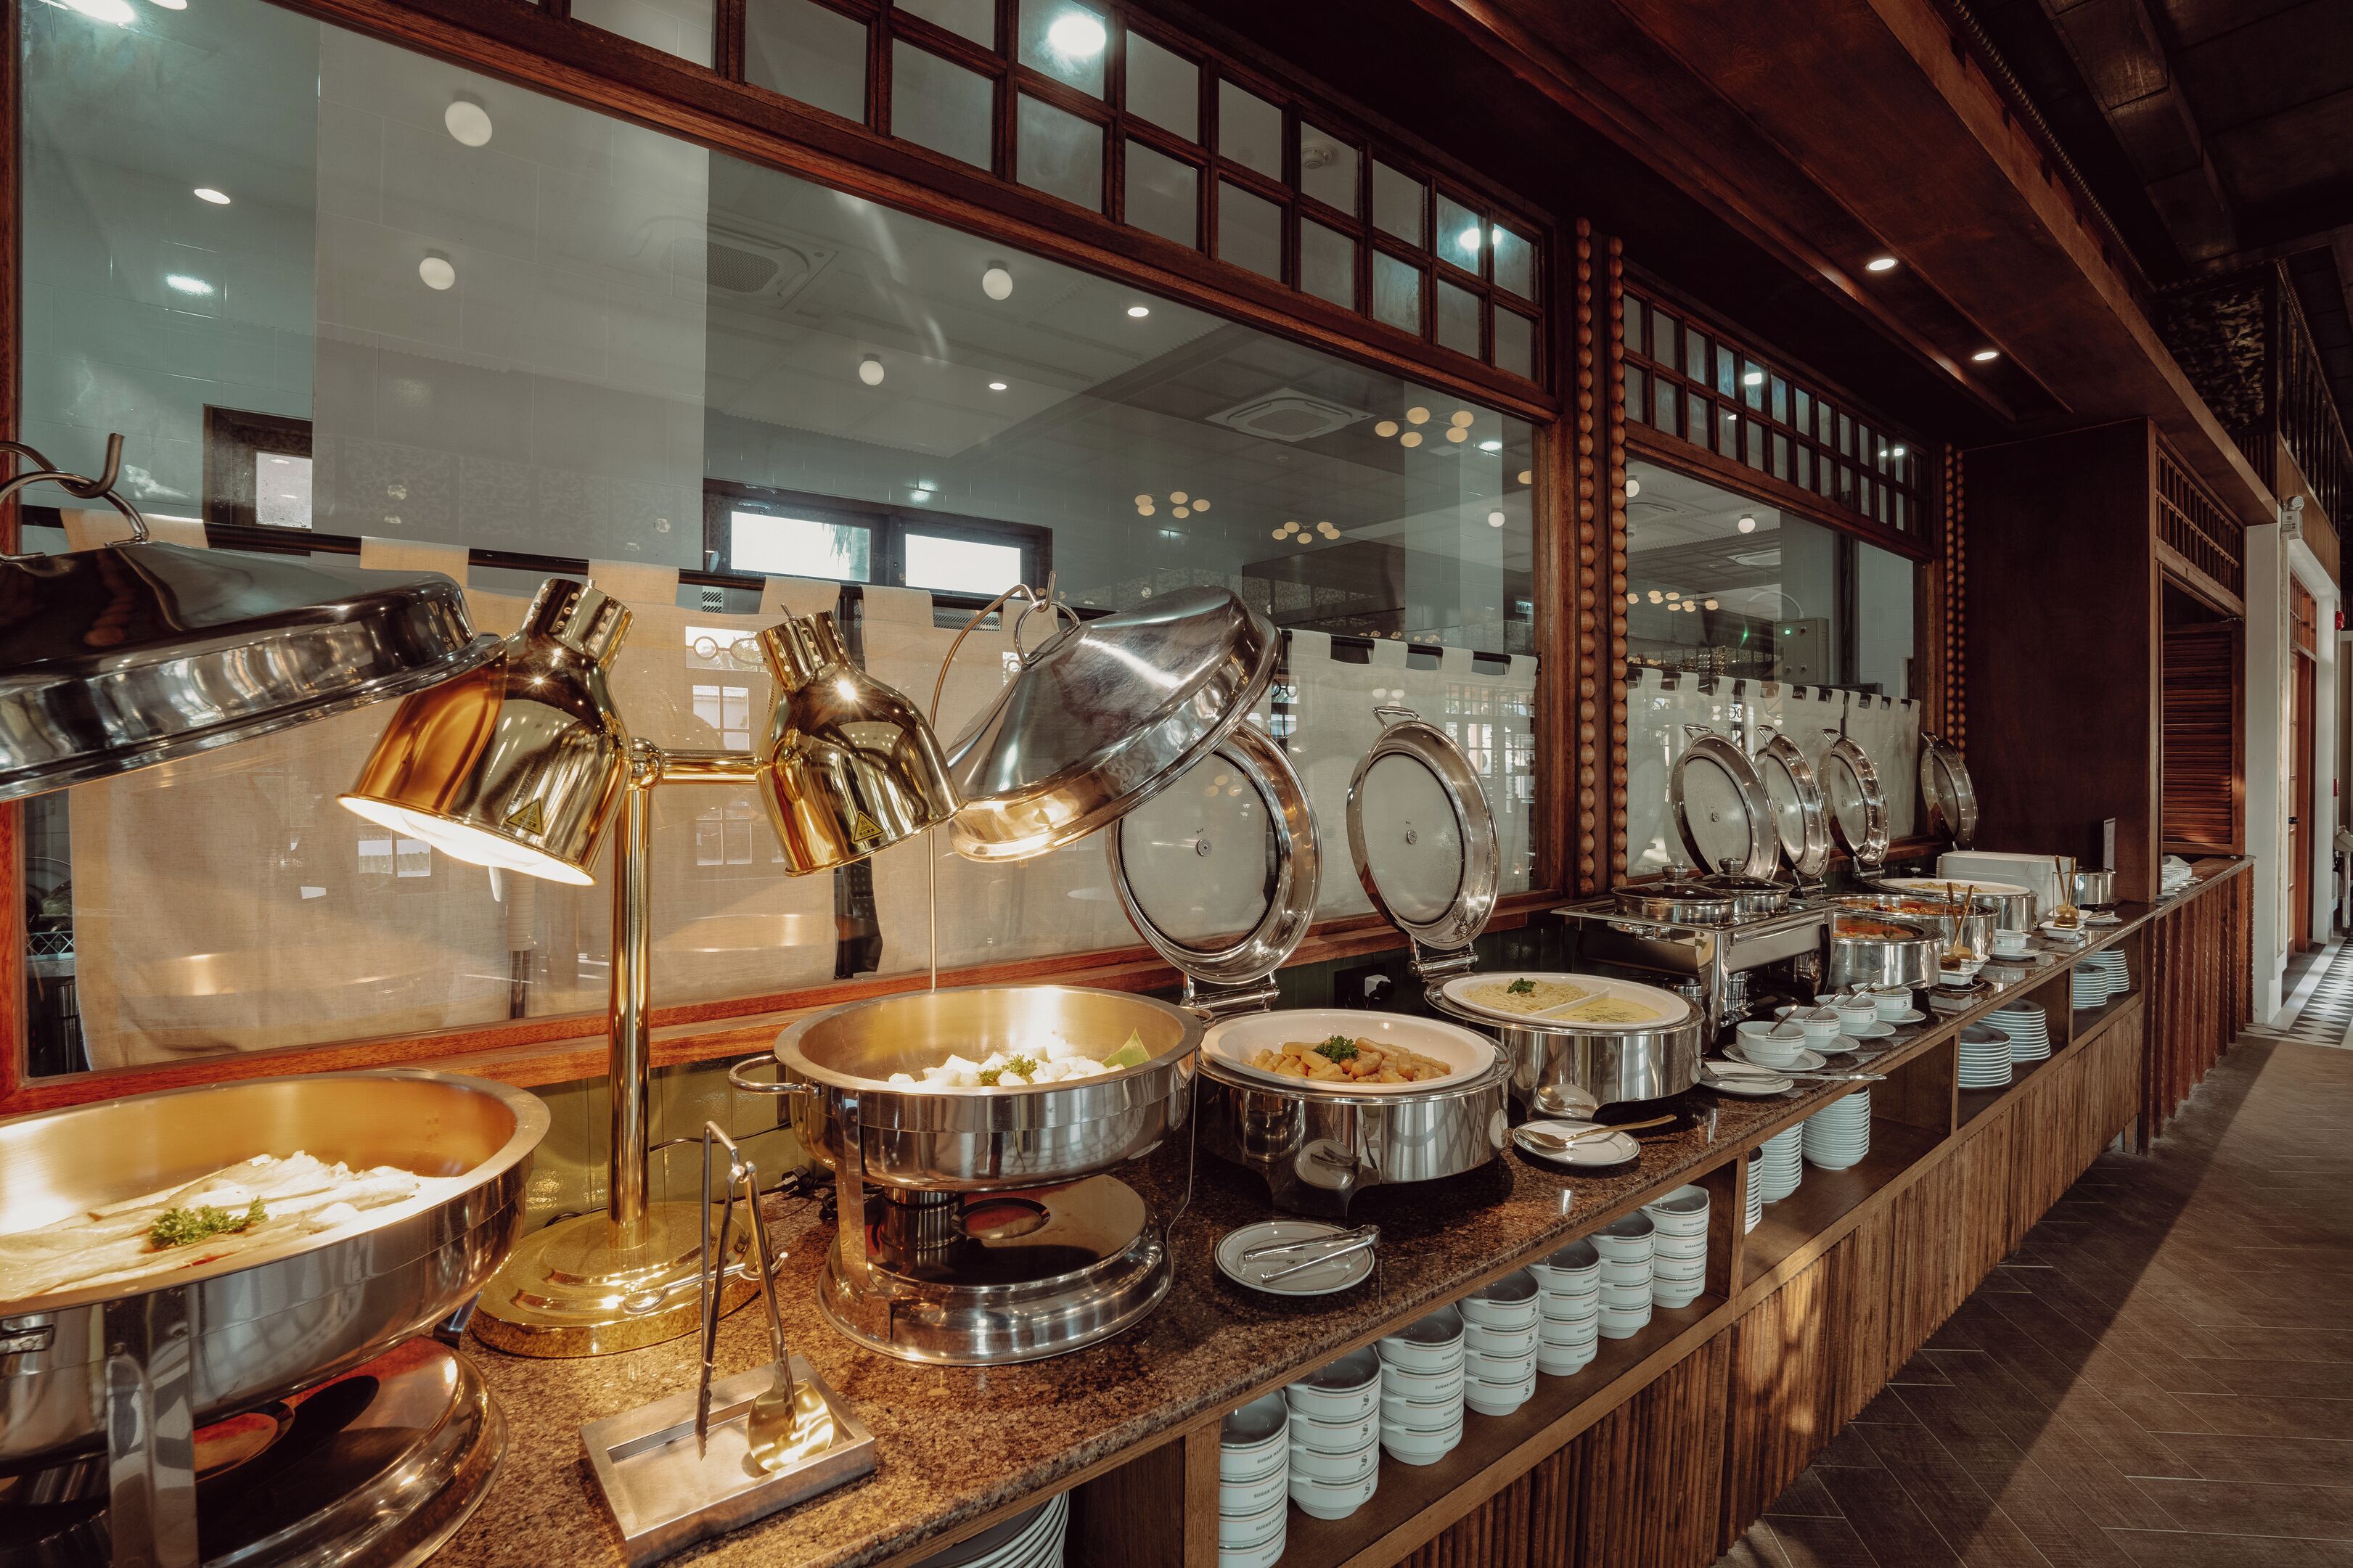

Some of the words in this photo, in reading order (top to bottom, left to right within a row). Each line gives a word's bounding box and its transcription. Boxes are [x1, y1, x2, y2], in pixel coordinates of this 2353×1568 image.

[1257, 1454, 1272, 1464] SUGAR
[1254, 1489, 1270, 1498] SUGAR
[1256, 1521, 1272, 1531] SUGAR
[1262, 1549, 1276, 1561] SUGAR
